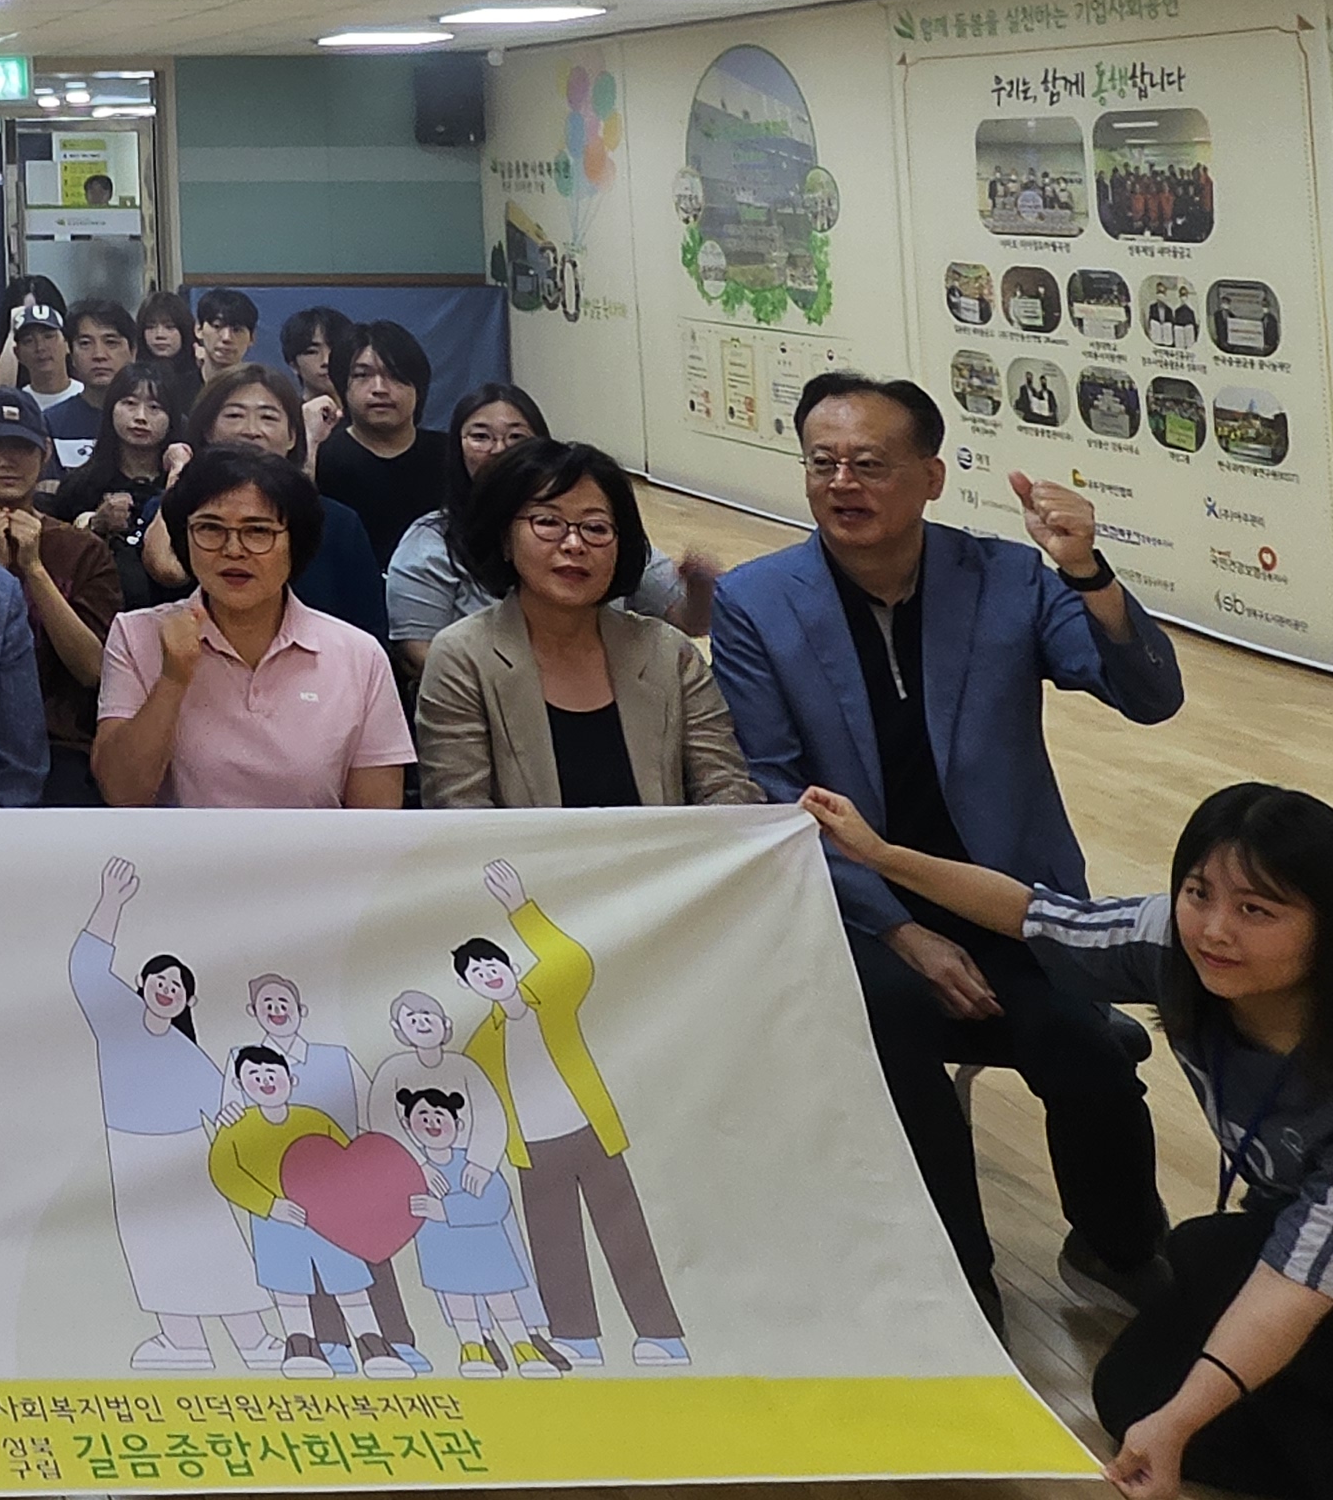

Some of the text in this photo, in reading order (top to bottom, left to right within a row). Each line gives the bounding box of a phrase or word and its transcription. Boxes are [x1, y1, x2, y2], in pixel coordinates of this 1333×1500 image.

[1005, 1, 1068, 34] 실천하는
[1039, 67, 1085, 107] 함께
[1091, 61, 1187, 107] 동행합니다
[175, 1393, 466, 1424] 인덕원삼천사복지재단
[2, 1436, 54, 1459] 성북
[74, 1429, 490, 1480] 길음종합사회복지관
[9, 1458, 62, 1481] 구립
